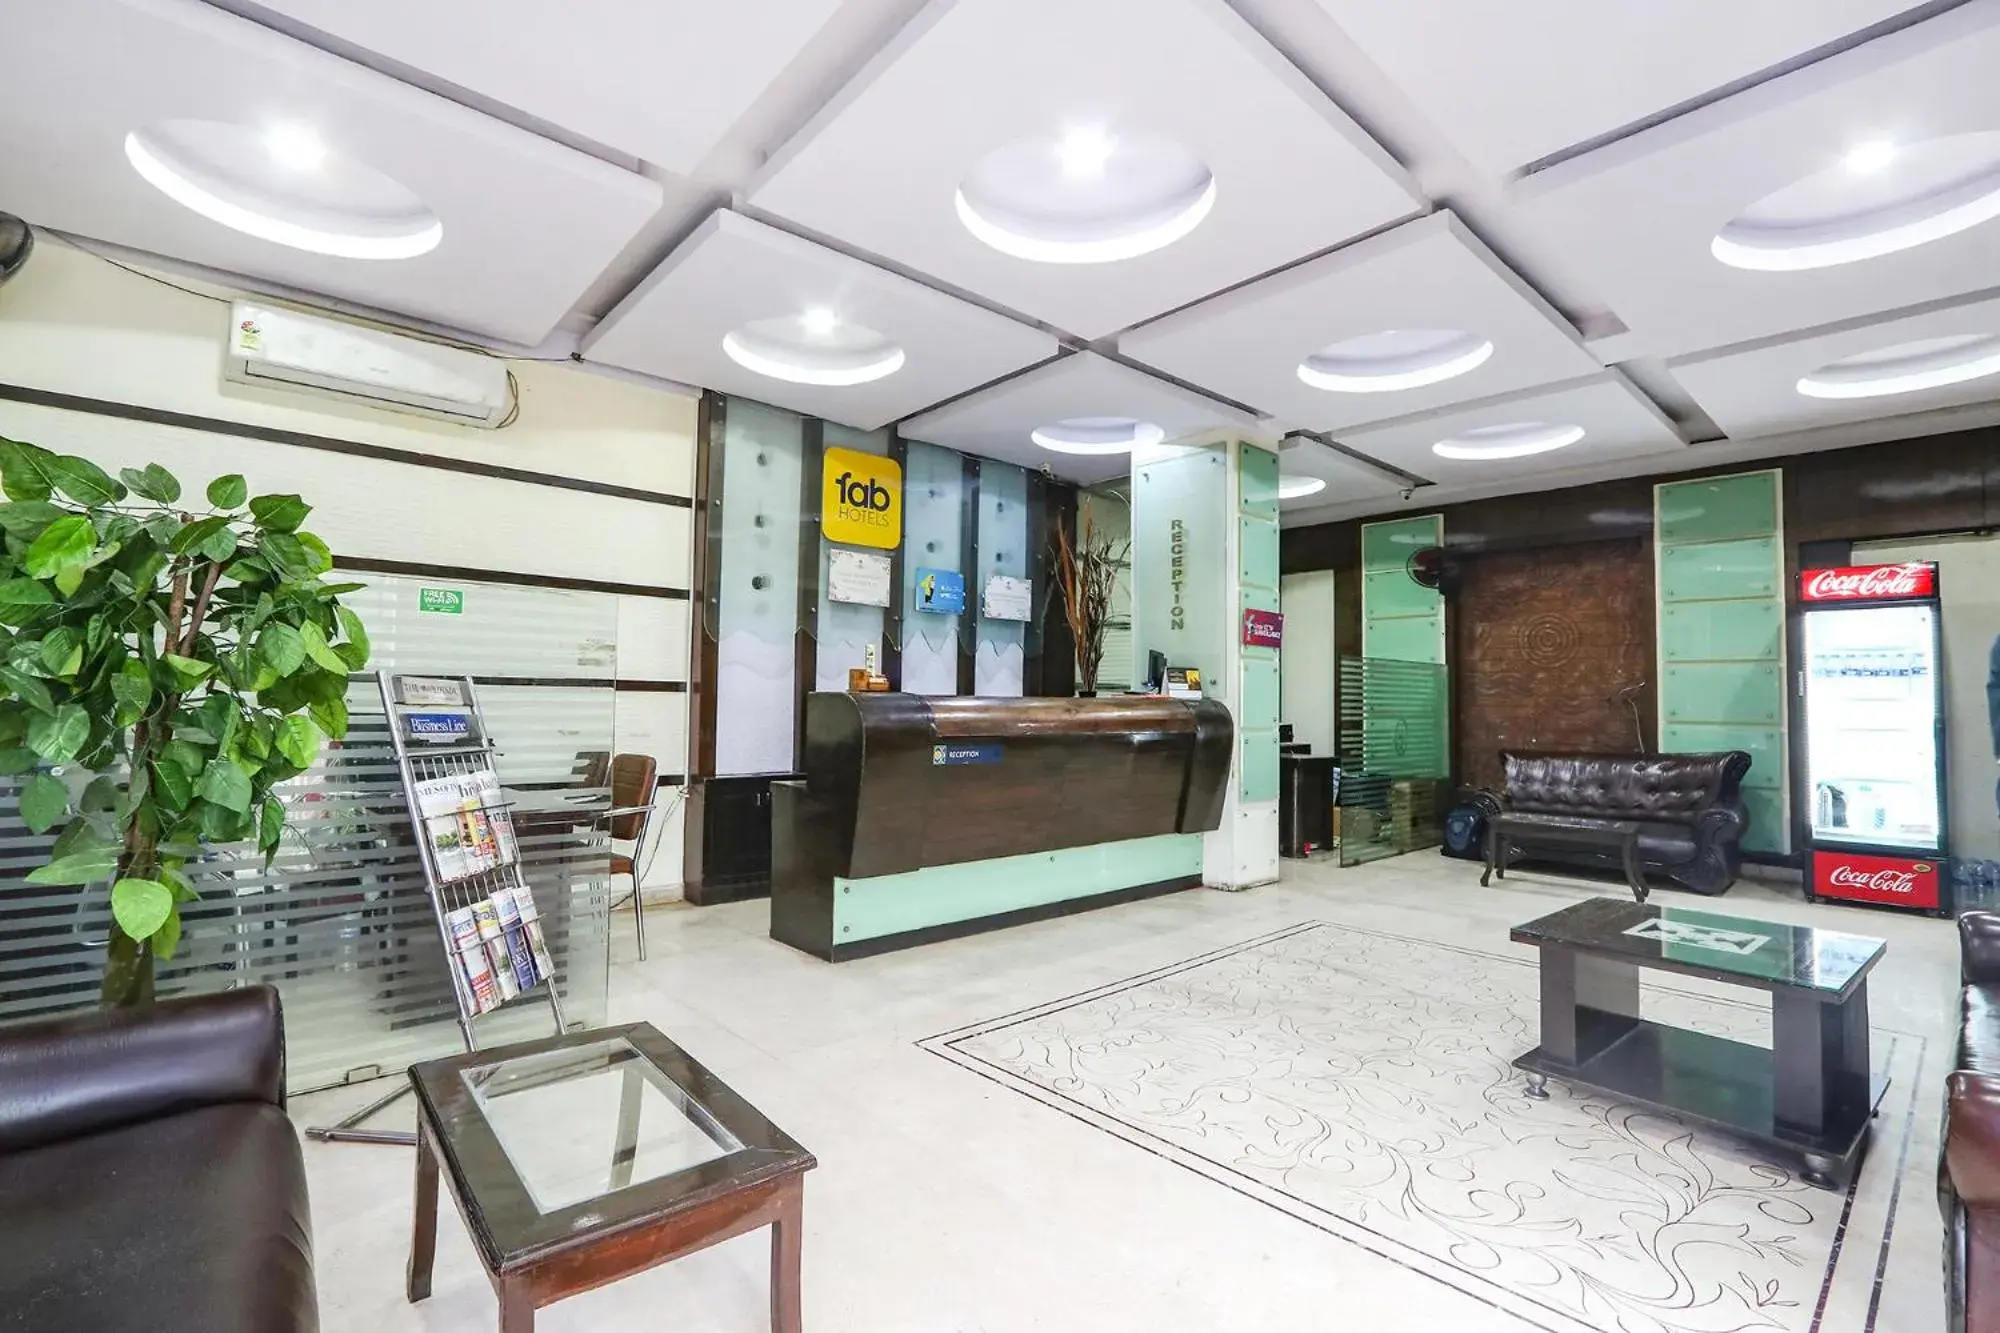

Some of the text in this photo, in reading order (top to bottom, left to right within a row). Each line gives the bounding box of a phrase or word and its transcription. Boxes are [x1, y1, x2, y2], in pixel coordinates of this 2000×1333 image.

[835, 471, 891, 513] fab
[838, 506, 890, 528] HOTELS
[1171, 519, 1184, 630] RECEPTION
[1808, 565, 1919, 598] Coca-Cola
[423, 590, 446, 598] FREE
[949, 750, 980, 759] RECEPTION
[1829, 865, 1918, 893] Coca-Cola
